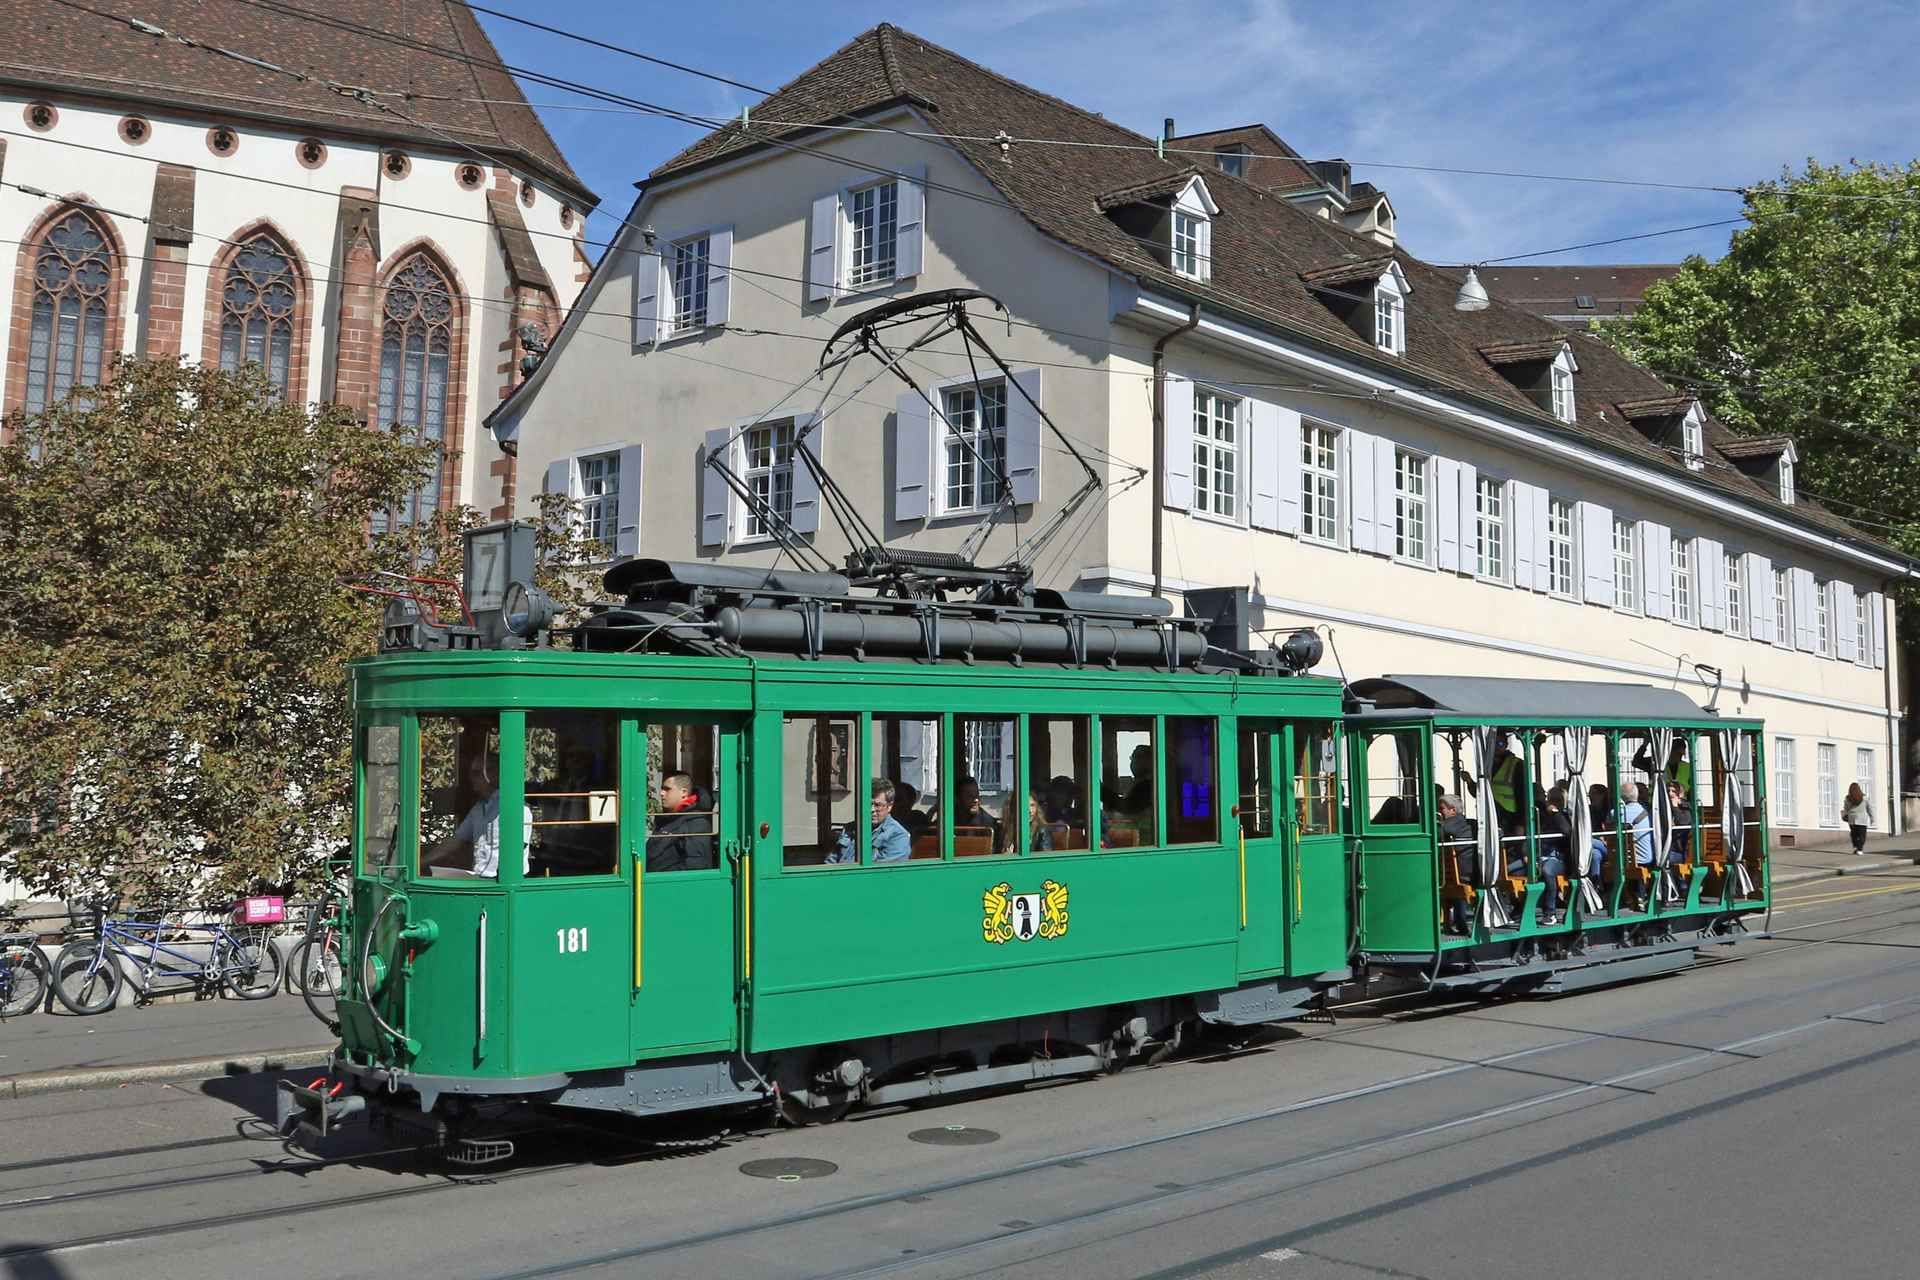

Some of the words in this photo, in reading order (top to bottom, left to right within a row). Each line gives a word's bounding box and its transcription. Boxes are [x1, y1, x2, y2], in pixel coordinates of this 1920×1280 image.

[481, 546, 497, 596] 7
[598, 794, 608, 816] 7
[557, 927, 588, 953] 181
